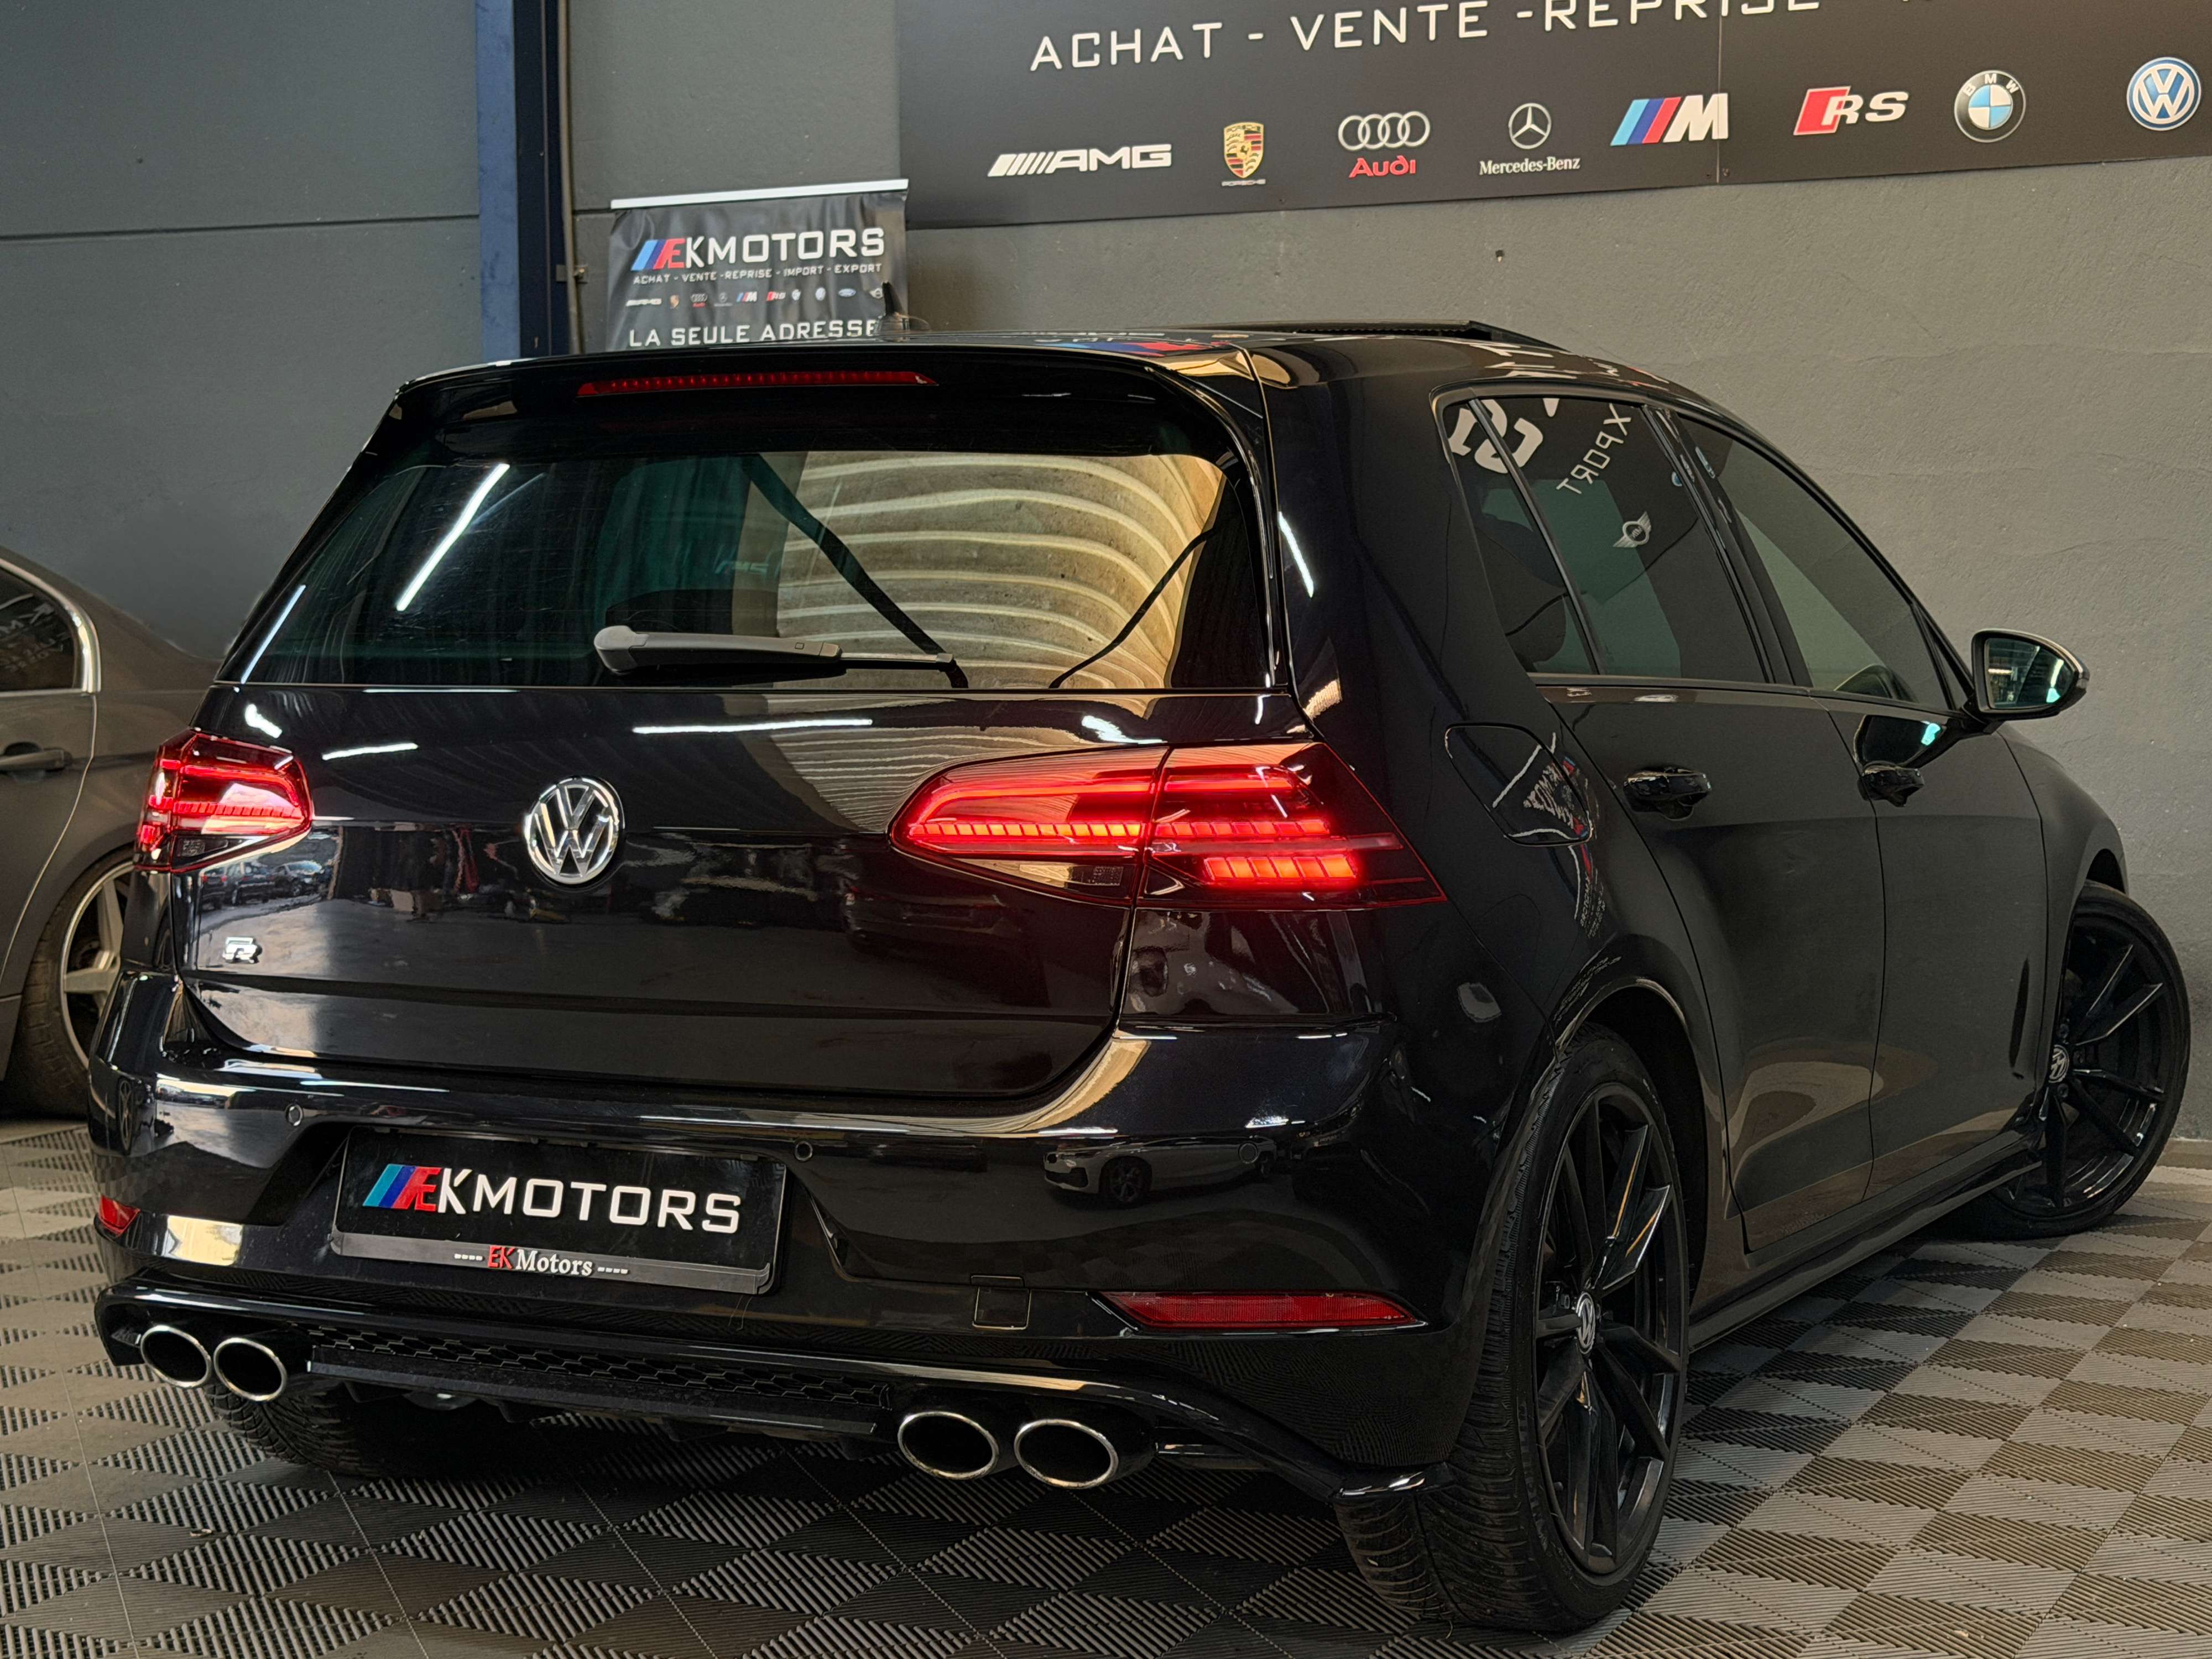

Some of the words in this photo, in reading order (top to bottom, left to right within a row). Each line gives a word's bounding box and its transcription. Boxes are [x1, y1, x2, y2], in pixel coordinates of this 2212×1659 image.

[1030, 22, 1223, 72] ACHAT
[1290, 0, 1489, 51] VENTE
[1820, 91, 1909, 126] RS
[1349, 155, 1416, 178] Audi
[1479, 156, 1580, 175] Mercedes-Benz
[633, 274, 671, 285] ACHAT
[681, 271, 717, 283] VENTE
[783, 264, 825, 278] IMPORT
[834, 263, 883, 275] EXPORT
[629, 329, 661, 348] LA
[671, 324, 751, 346] SEULE
[759, 319, 878, 341] ADRESSE
[516, 1249, 593, 1277] Motors
